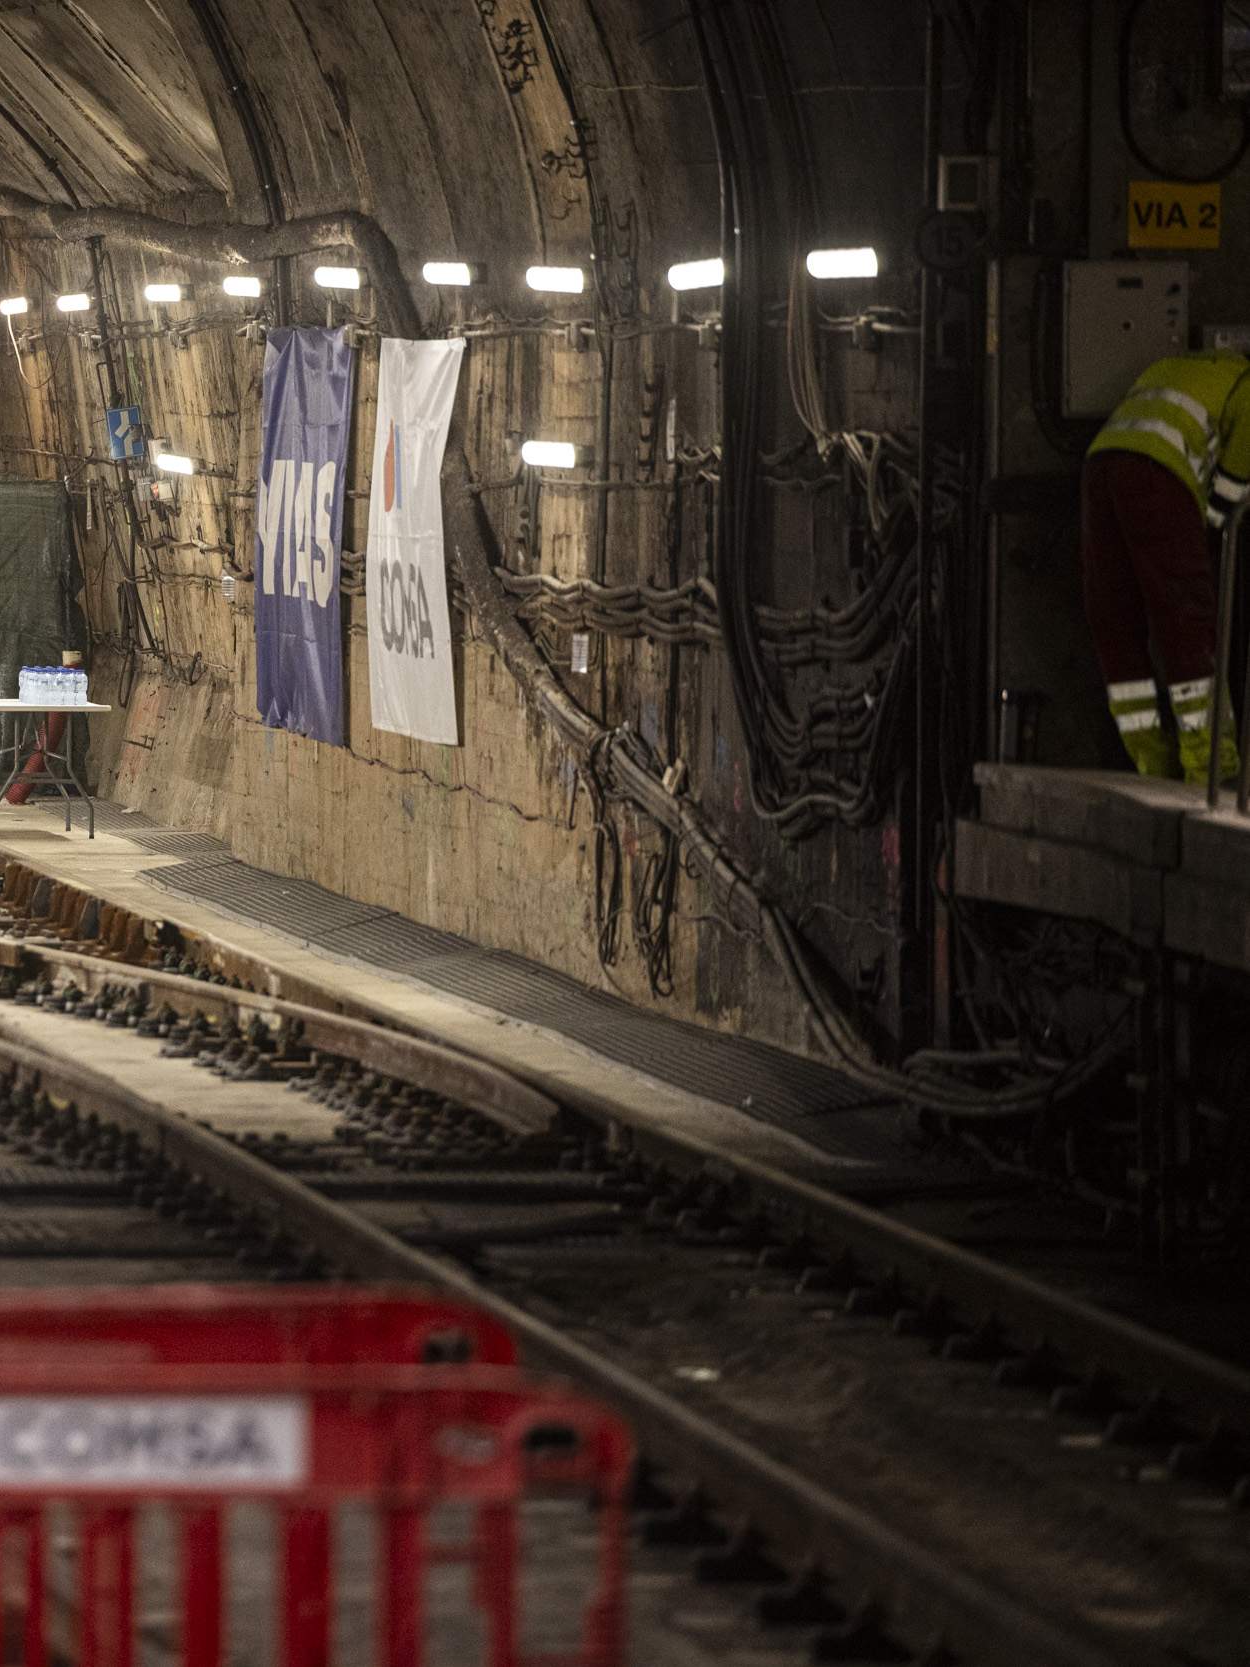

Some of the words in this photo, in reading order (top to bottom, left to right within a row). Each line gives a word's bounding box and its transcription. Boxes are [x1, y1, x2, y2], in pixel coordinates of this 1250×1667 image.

[1134, 202, 1188, 228] VIA
[1198, 203, 1217, 228] 2
[258, 460, 336, 608] VIAS
